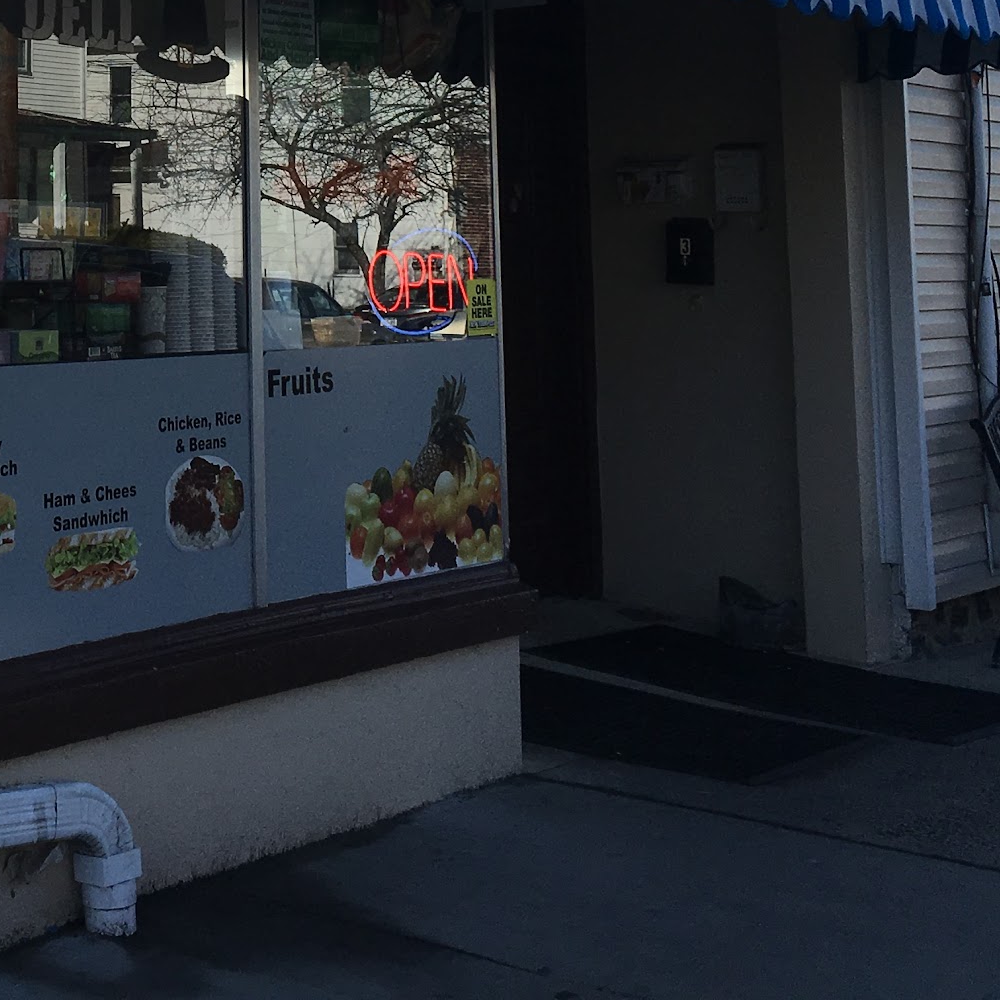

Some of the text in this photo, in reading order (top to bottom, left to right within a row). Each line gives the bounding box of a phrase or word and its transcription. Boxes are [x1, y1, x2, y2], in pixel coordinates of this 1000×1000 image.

[682, 239, 689, 254] 3
[369, 250, 475, 312] OPEN
[475, 284, 487, 295] ON
[471, 295, 491, 307] SALE
[471, 306, 493, 319] HERE
[267, 368, 333, 398] Fruits
[158, 411, 242, 433] Chicken, Rice
[175, 434, 227, 453] & Beans
[43, 484, 137, 509] Ham & Chees
[52, 507, 129, 533] Sandwhich
